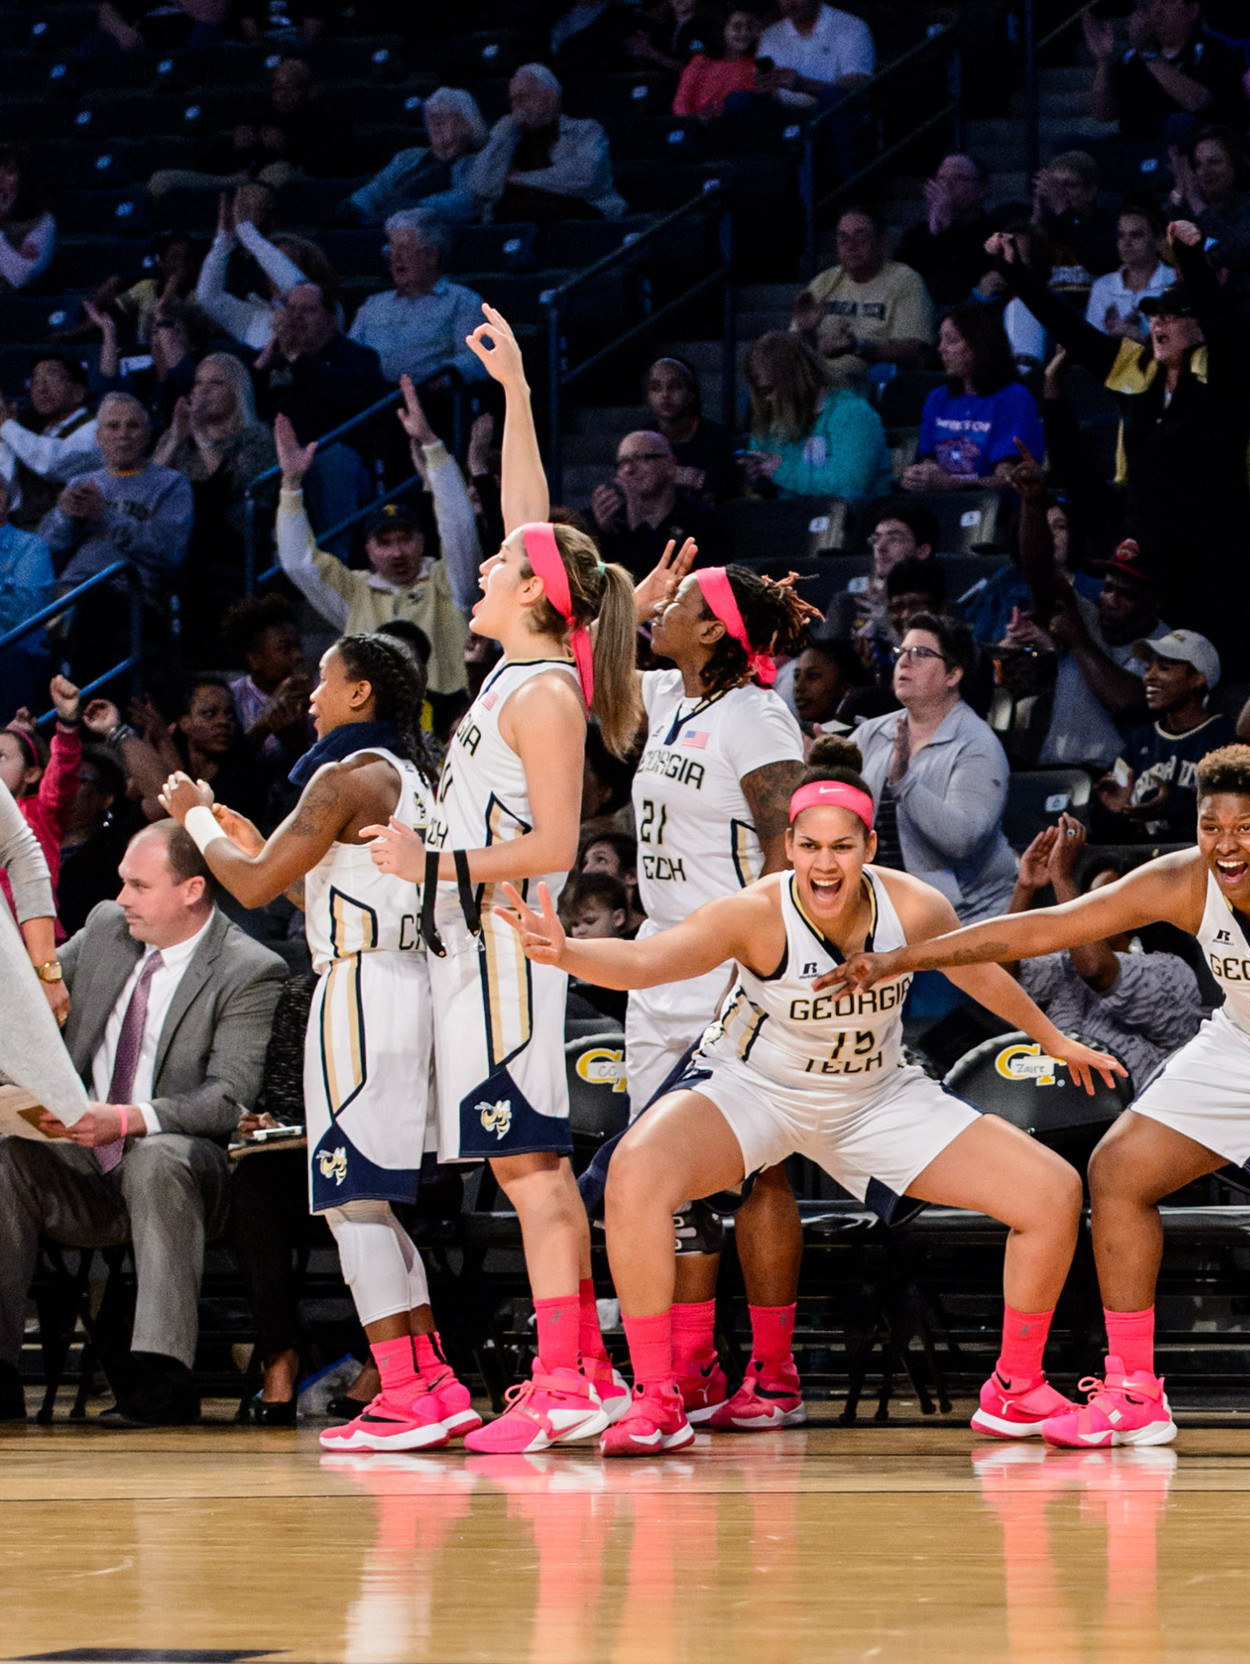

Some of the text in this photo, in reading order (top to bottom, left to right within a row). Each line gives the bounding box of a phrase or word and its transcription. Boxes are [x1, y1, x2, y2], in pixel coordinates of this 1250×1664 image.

[640, 799, 668, 845] 21
[789, 976, 911, 1021] GEORGIA
[831, 1029, 876, 1060] 15
